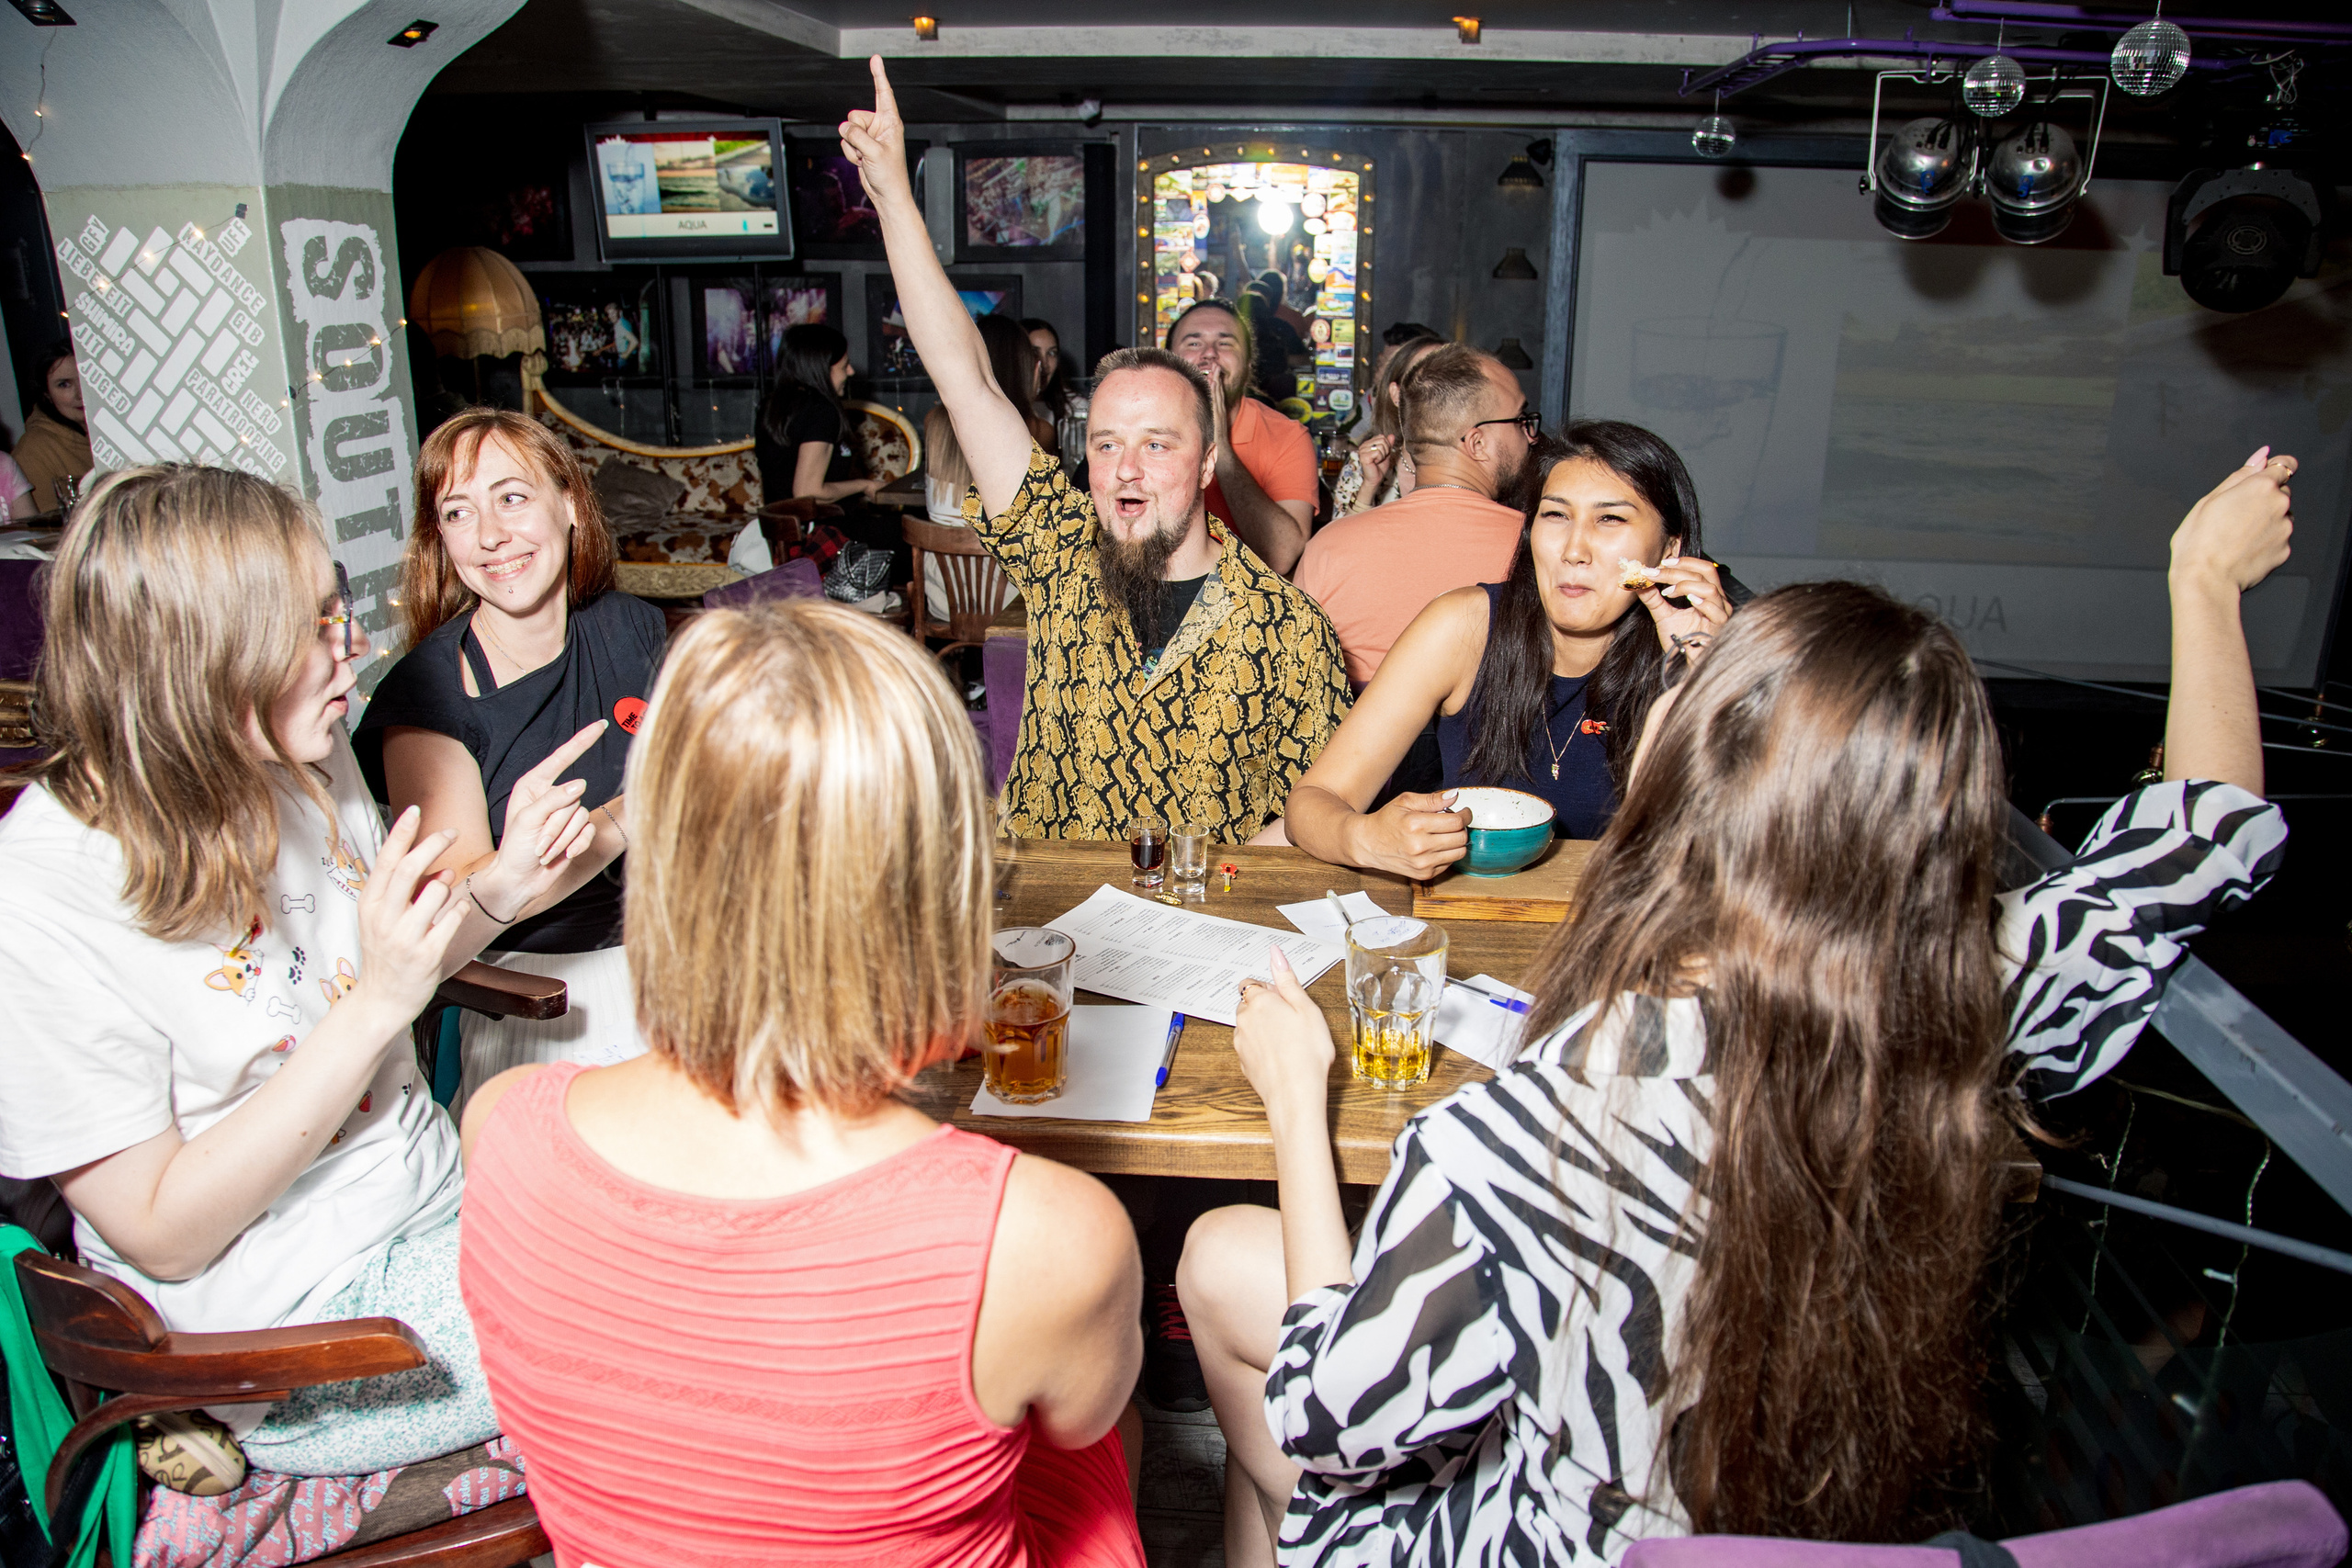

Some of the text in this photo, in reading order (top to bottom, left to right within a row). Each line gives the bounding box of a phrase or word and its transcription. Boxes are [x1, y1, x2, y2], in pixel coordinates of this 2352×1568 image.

[80, 217, 107, 254] GFY
[220, 220, 247, 254] UFF
[678, 220, 707, 231] AQUA
[74, 325, 105, 356] JIT
[232, 312, 263, 343] GIB
[80, 362, 130, 412] JUGED
[187, 370, 284, 471] PARATROOPING
[242, 392, 280, 433] NERD
[302, 235, 410, 705] SOUTH
[621, 712, 638, 728] TIME
